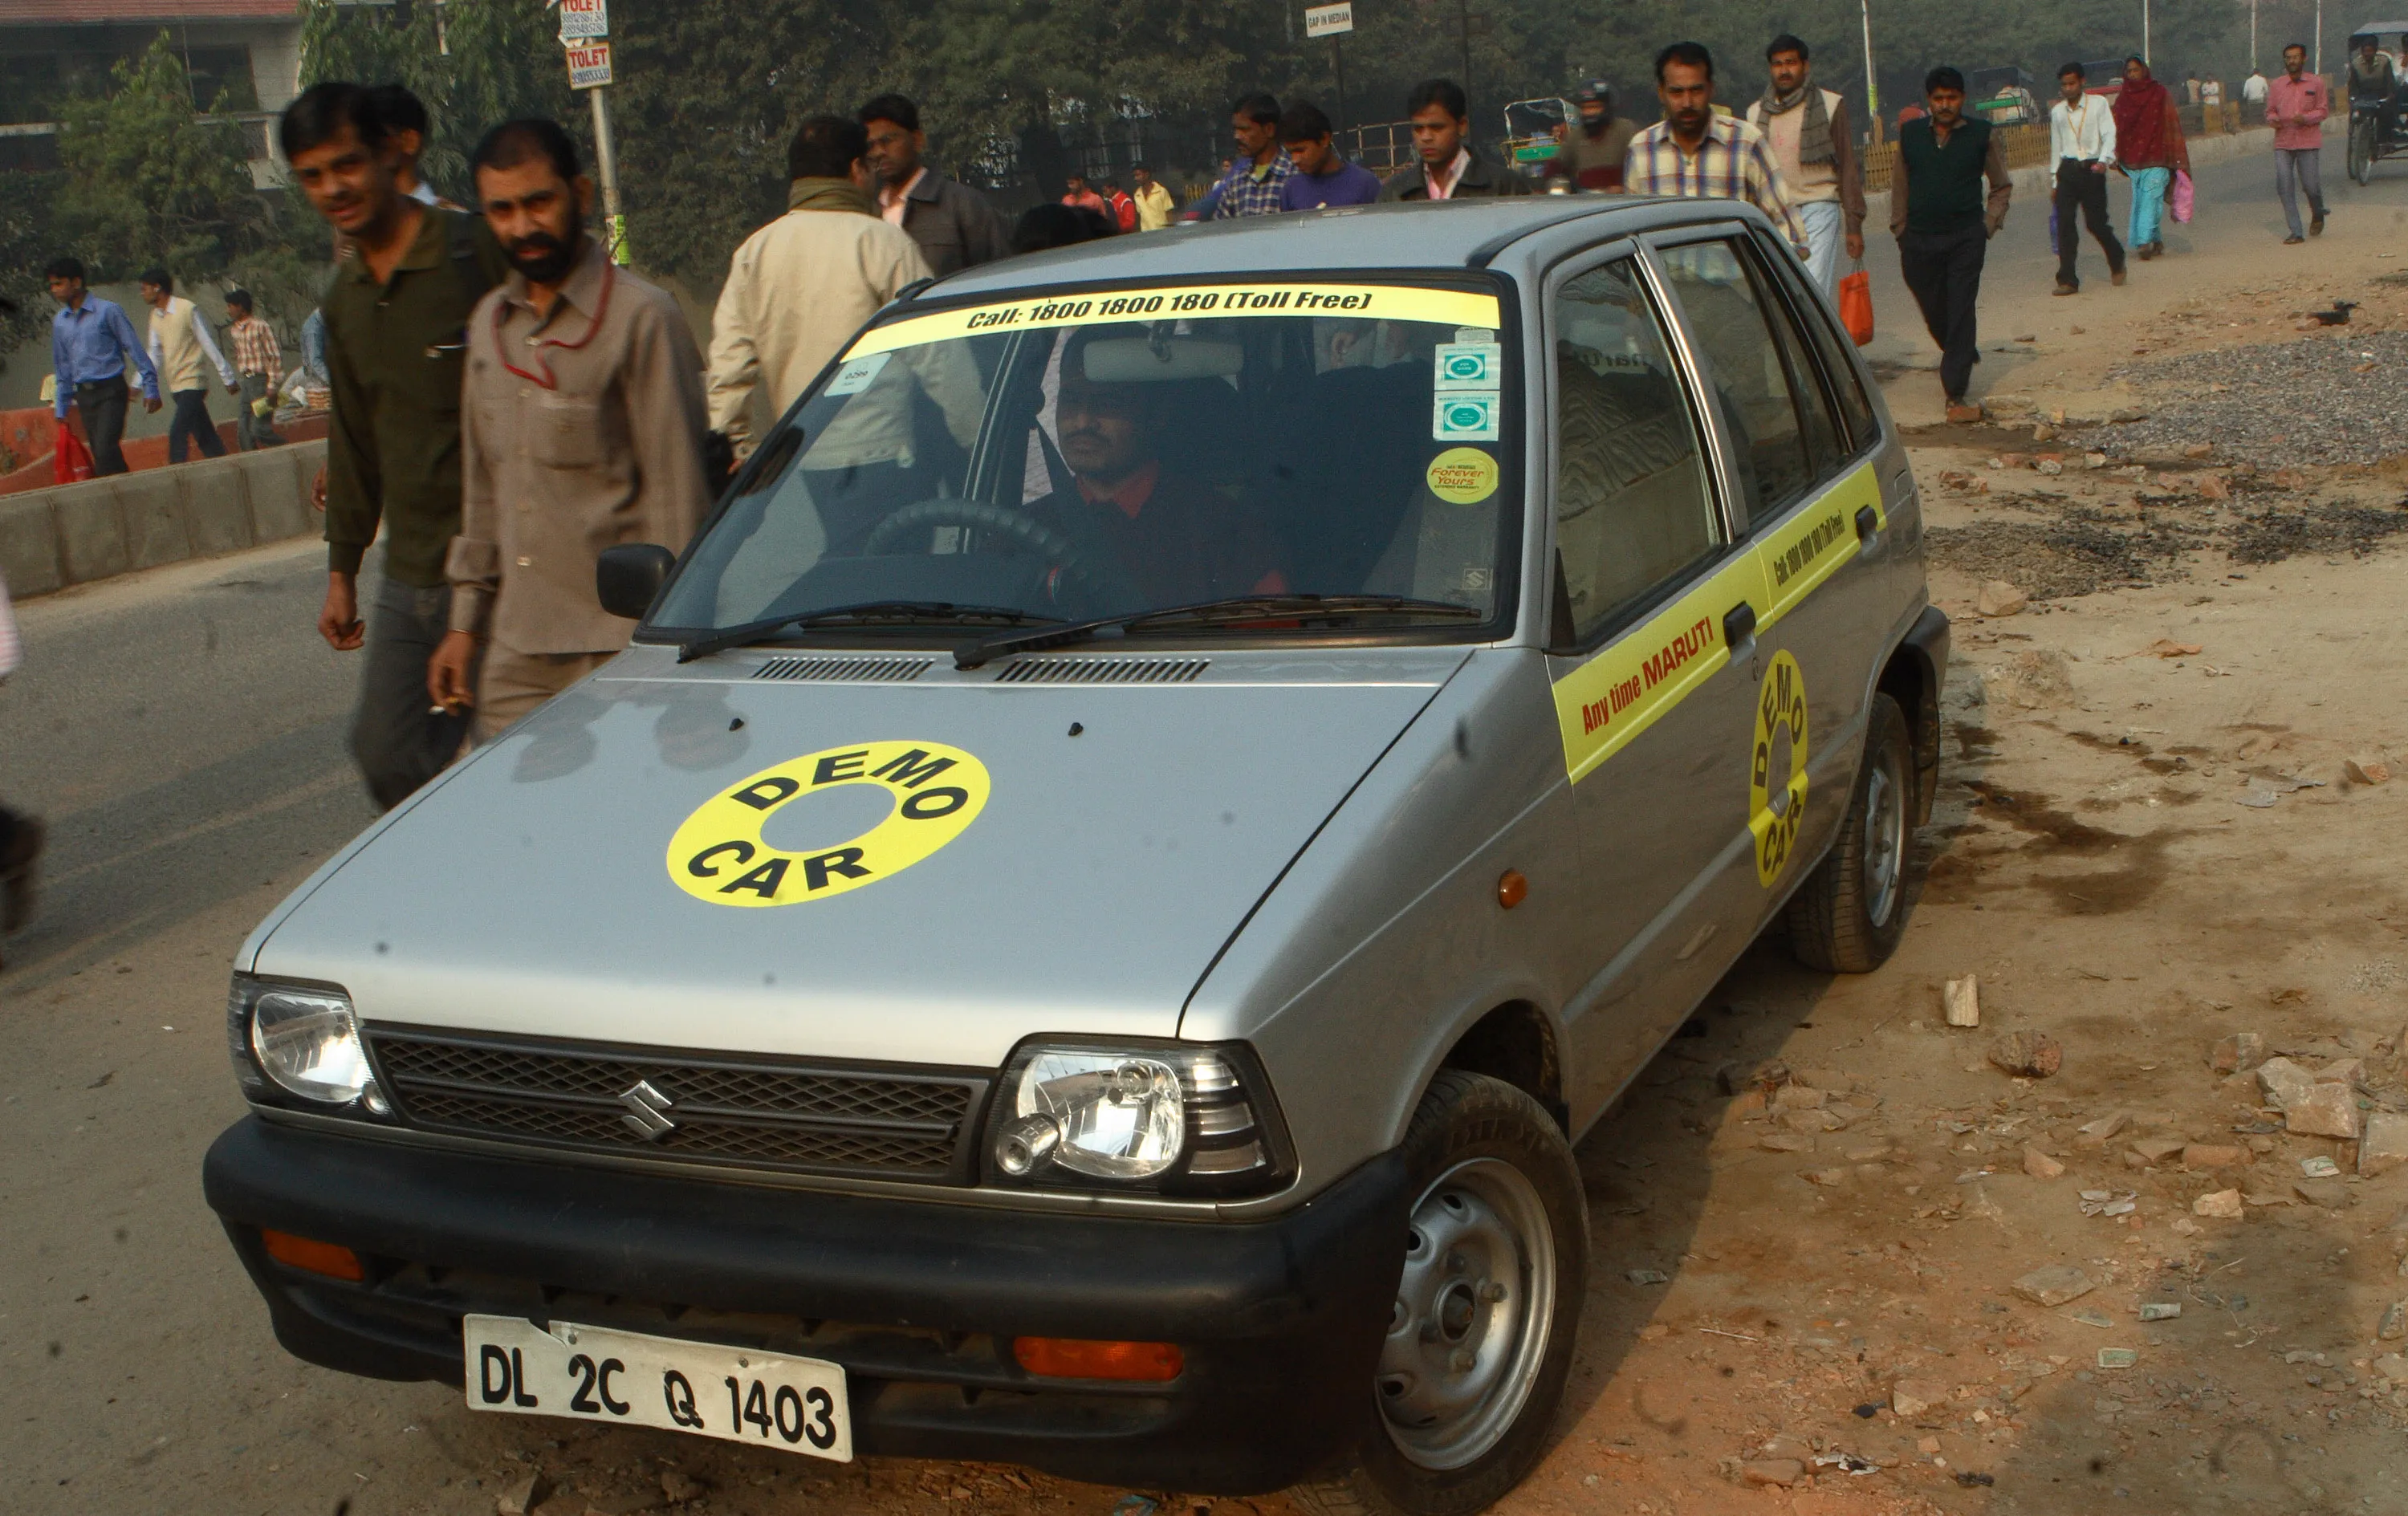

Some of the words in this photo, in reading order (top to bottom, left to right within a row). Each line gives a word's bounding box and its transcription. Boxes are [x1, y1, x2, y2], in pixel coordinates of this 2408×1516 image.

[1308, 15, 1320, 28] GAP
[1320, 14, 1328, 26] IN
[1328, 11, 1350, 24] MEDIAN
[568, 48, 608, 68] TOLET
[966, 307, 1023, 329] Call:
[1030, 300, 1092, 321] 1800
[1099, 295, 1162, 315] 1800
[1170, 293, 1221, 312] 180
[1224, 291, 1290, 309] (Toll
[1293, 291, 1373, 310] Free)
[1430, 467, 1484, 478] Forever
[1438, 476, 1475, 486] Yours
[1581, 696, 1609, 736] Any
[1609, 675, 1641, 714] time
[1641, 616, 1714, 690] MARUTI
[1754, 663, 1804, 788] DEMO
[730, 749, 969, 820] DEMO
[1762, 789, 1802, 875] CAR
[687, 840, 874, 898] CAR
[481, 1343, 539, 1408] DL
[568, 1353, 631, 1416] 2C
[663, 1369, 705, 1430] Q
[724, 1376, 837, 1450] 1403
